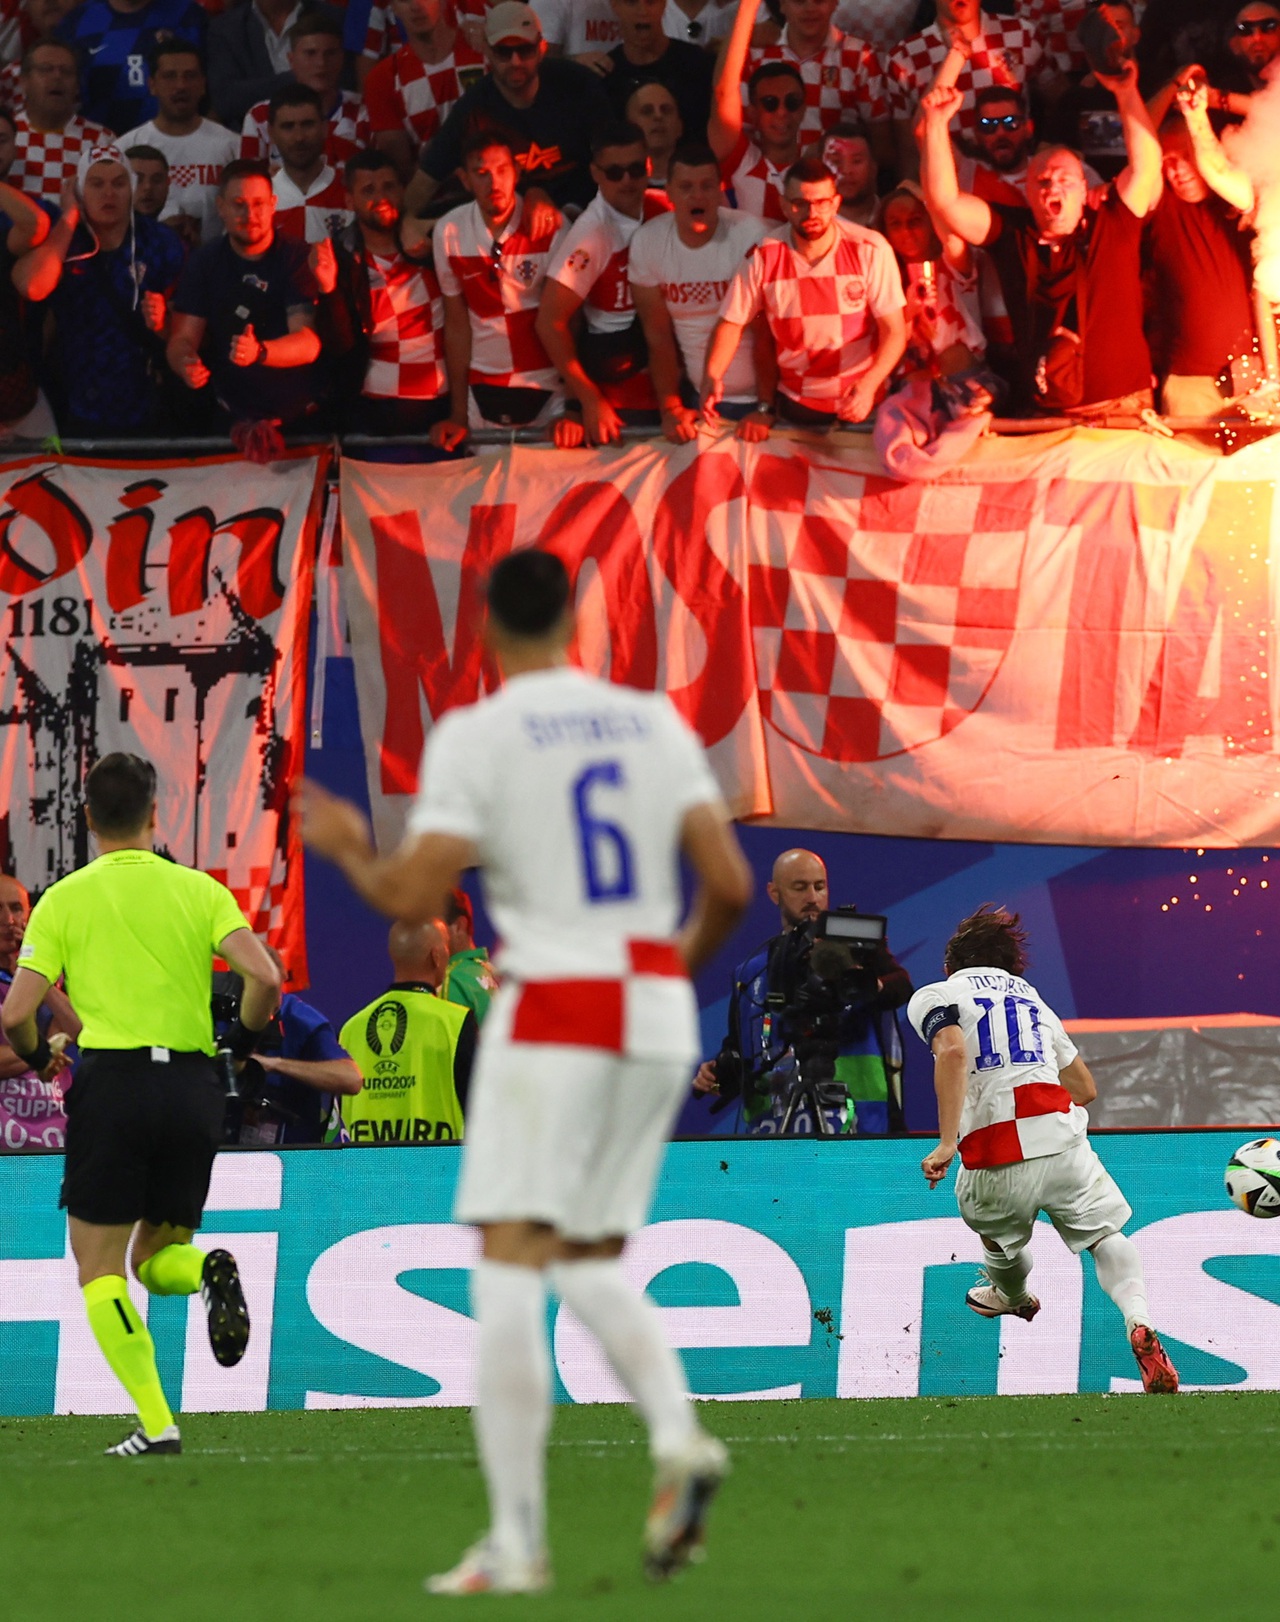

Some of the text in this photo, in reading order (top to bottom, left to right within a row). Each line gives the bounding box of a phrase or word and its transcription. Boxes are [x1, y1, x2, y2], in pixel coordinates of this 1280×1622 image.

[127, 54, 145, 87] 8
[571, 756, 637, 902] 6
[973, 994, 1046, 1073] 10
